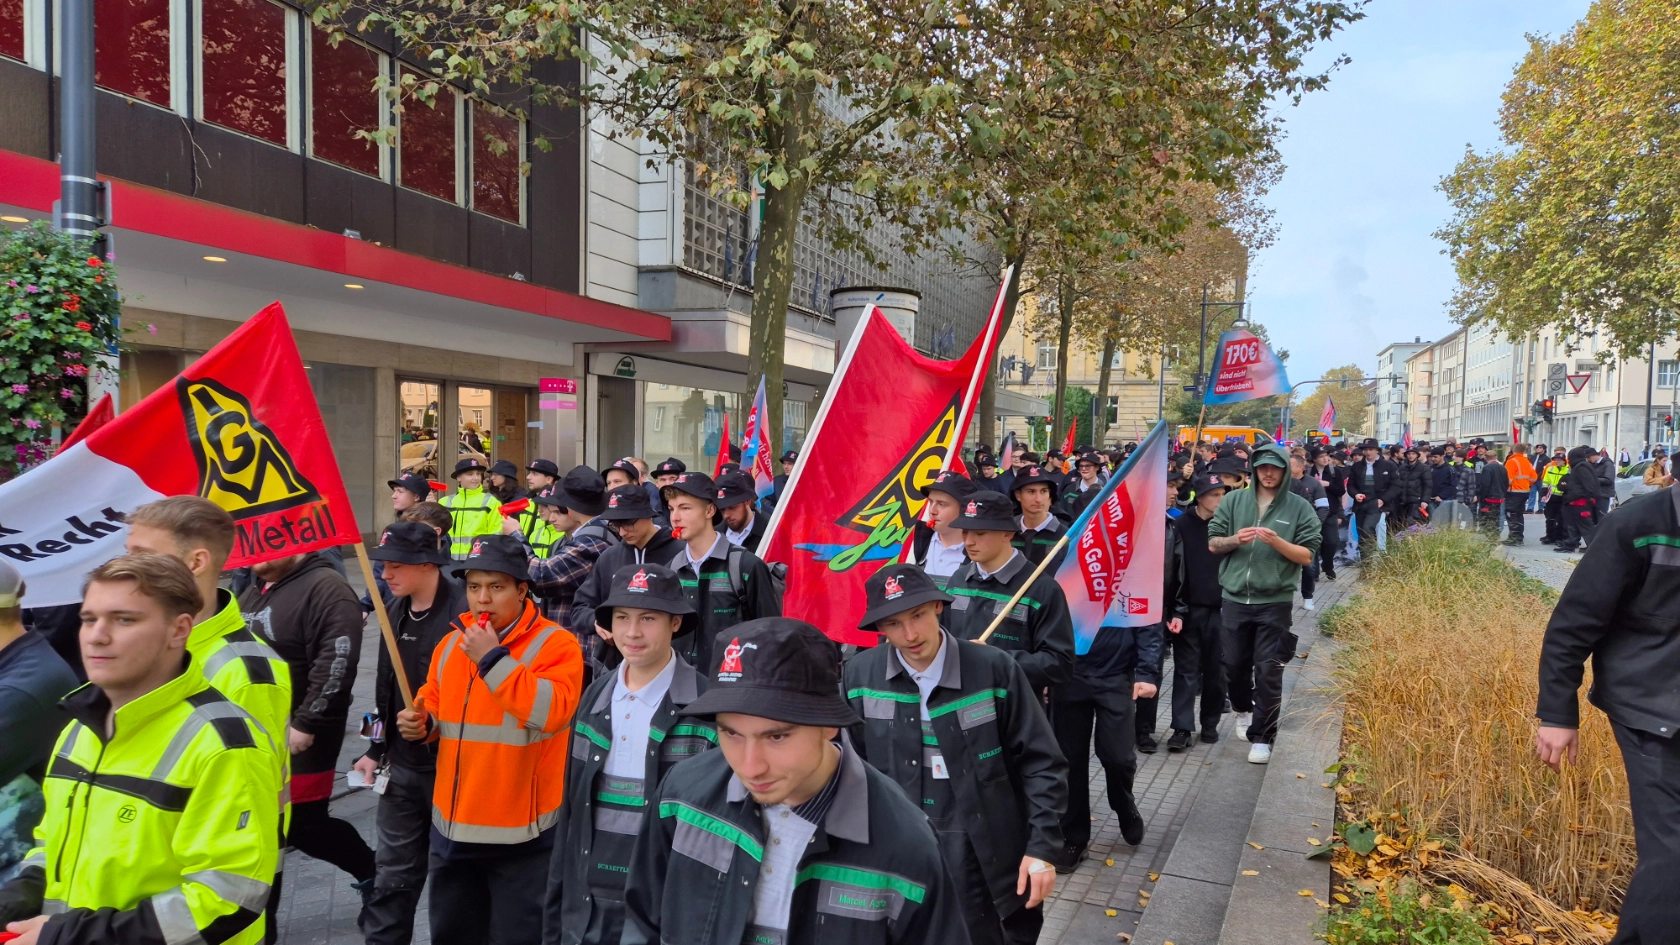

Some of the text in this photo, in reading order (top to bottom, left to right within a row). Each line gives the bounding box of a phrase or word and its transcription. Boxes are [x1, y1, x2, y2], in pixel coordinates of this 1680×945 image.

[1226, 341, 1258, 365] 170€
[0, 506, 127, 562] Recht
[236, 504, 337, 558] Metall
[1085, 548, 1106, 597] Geld!
[120, 807, 136, 820] ZF
[839, 894, 866, 907] Marcel
